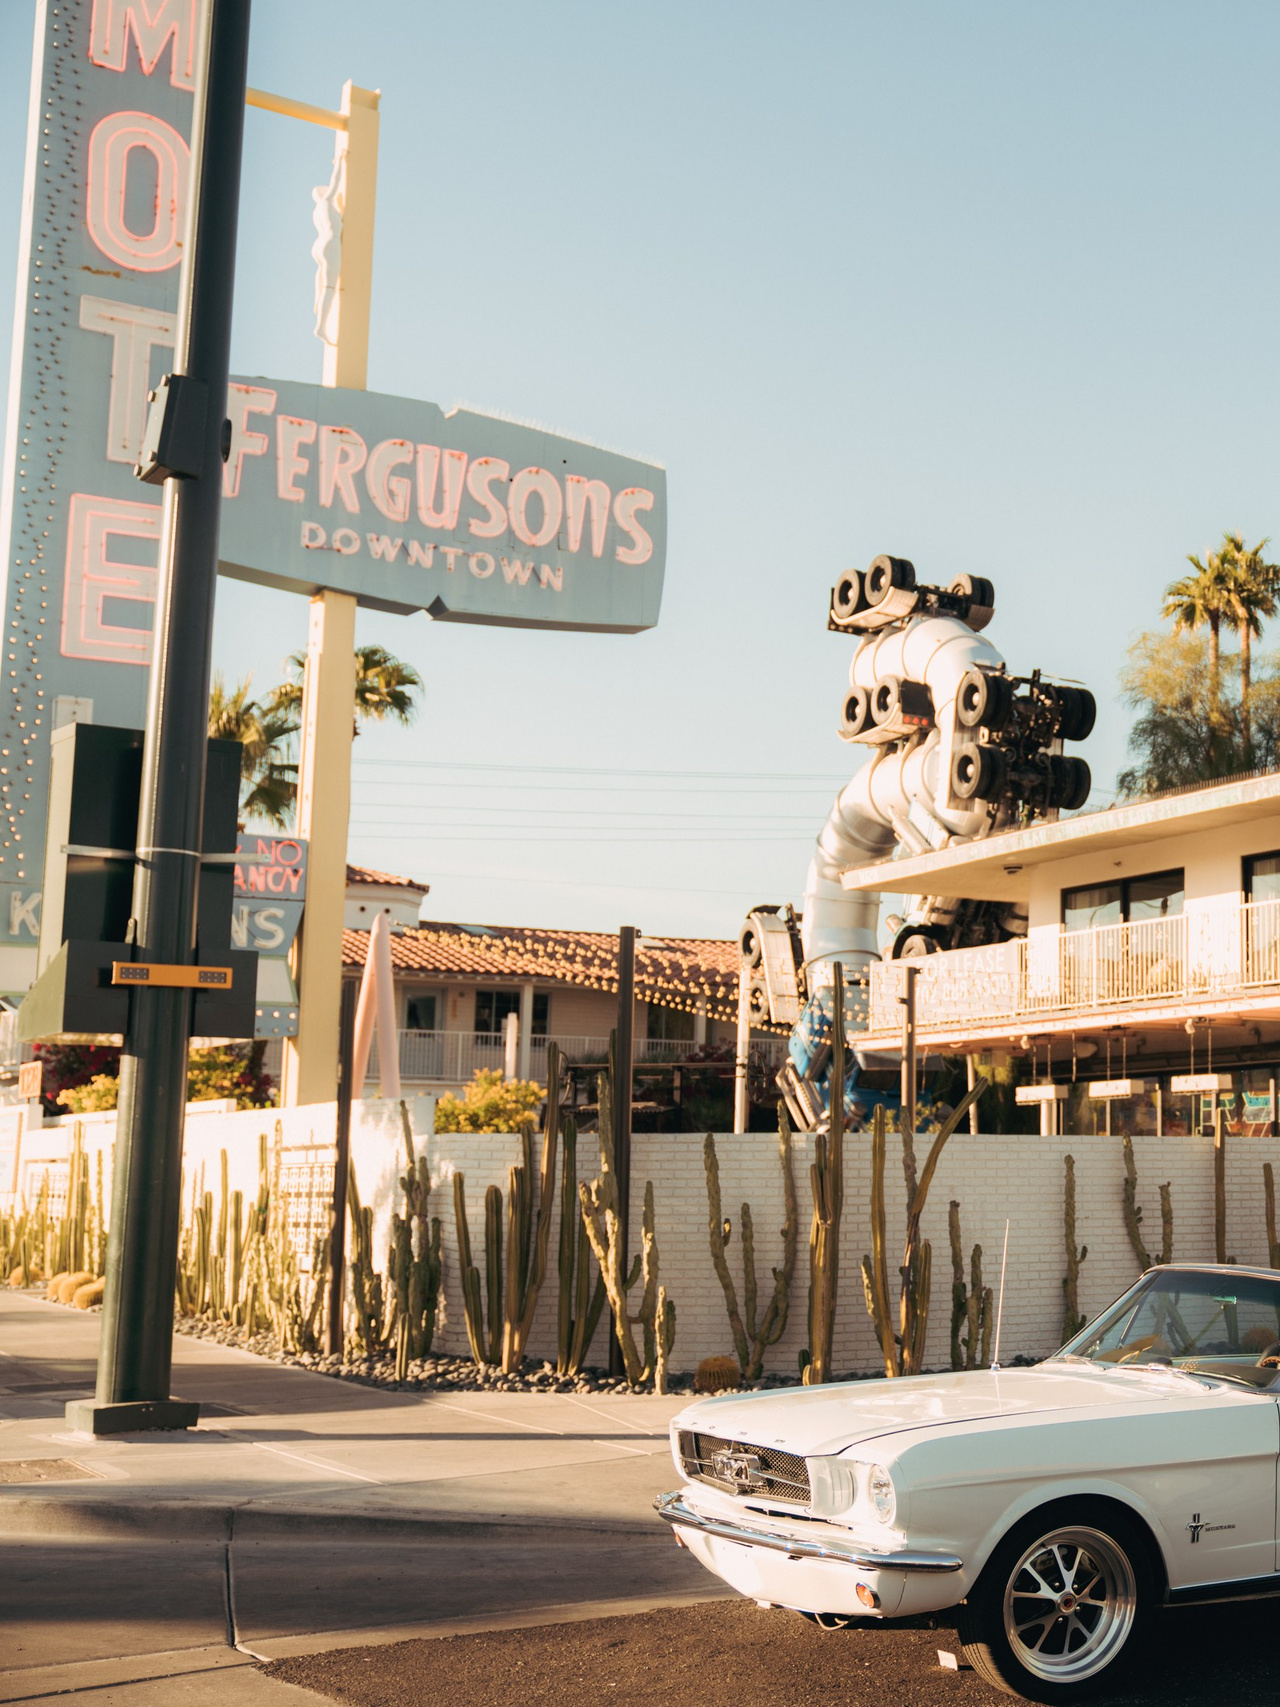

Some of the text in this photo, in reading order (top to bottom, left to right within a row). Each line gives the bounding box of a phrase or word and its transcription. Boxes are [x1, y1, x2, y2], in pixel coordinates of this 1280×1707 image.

[52, 0, 196, 732] MOTE
[224, 382, 654, 565] FERGUSONS
[302, 520, 563, 592] DOWNTOWN
[257, 838, 302, 866] NO
[955, 947, 1005, 977] LEASE
[1205, 1524, 1236, 1532] MUSTANG
